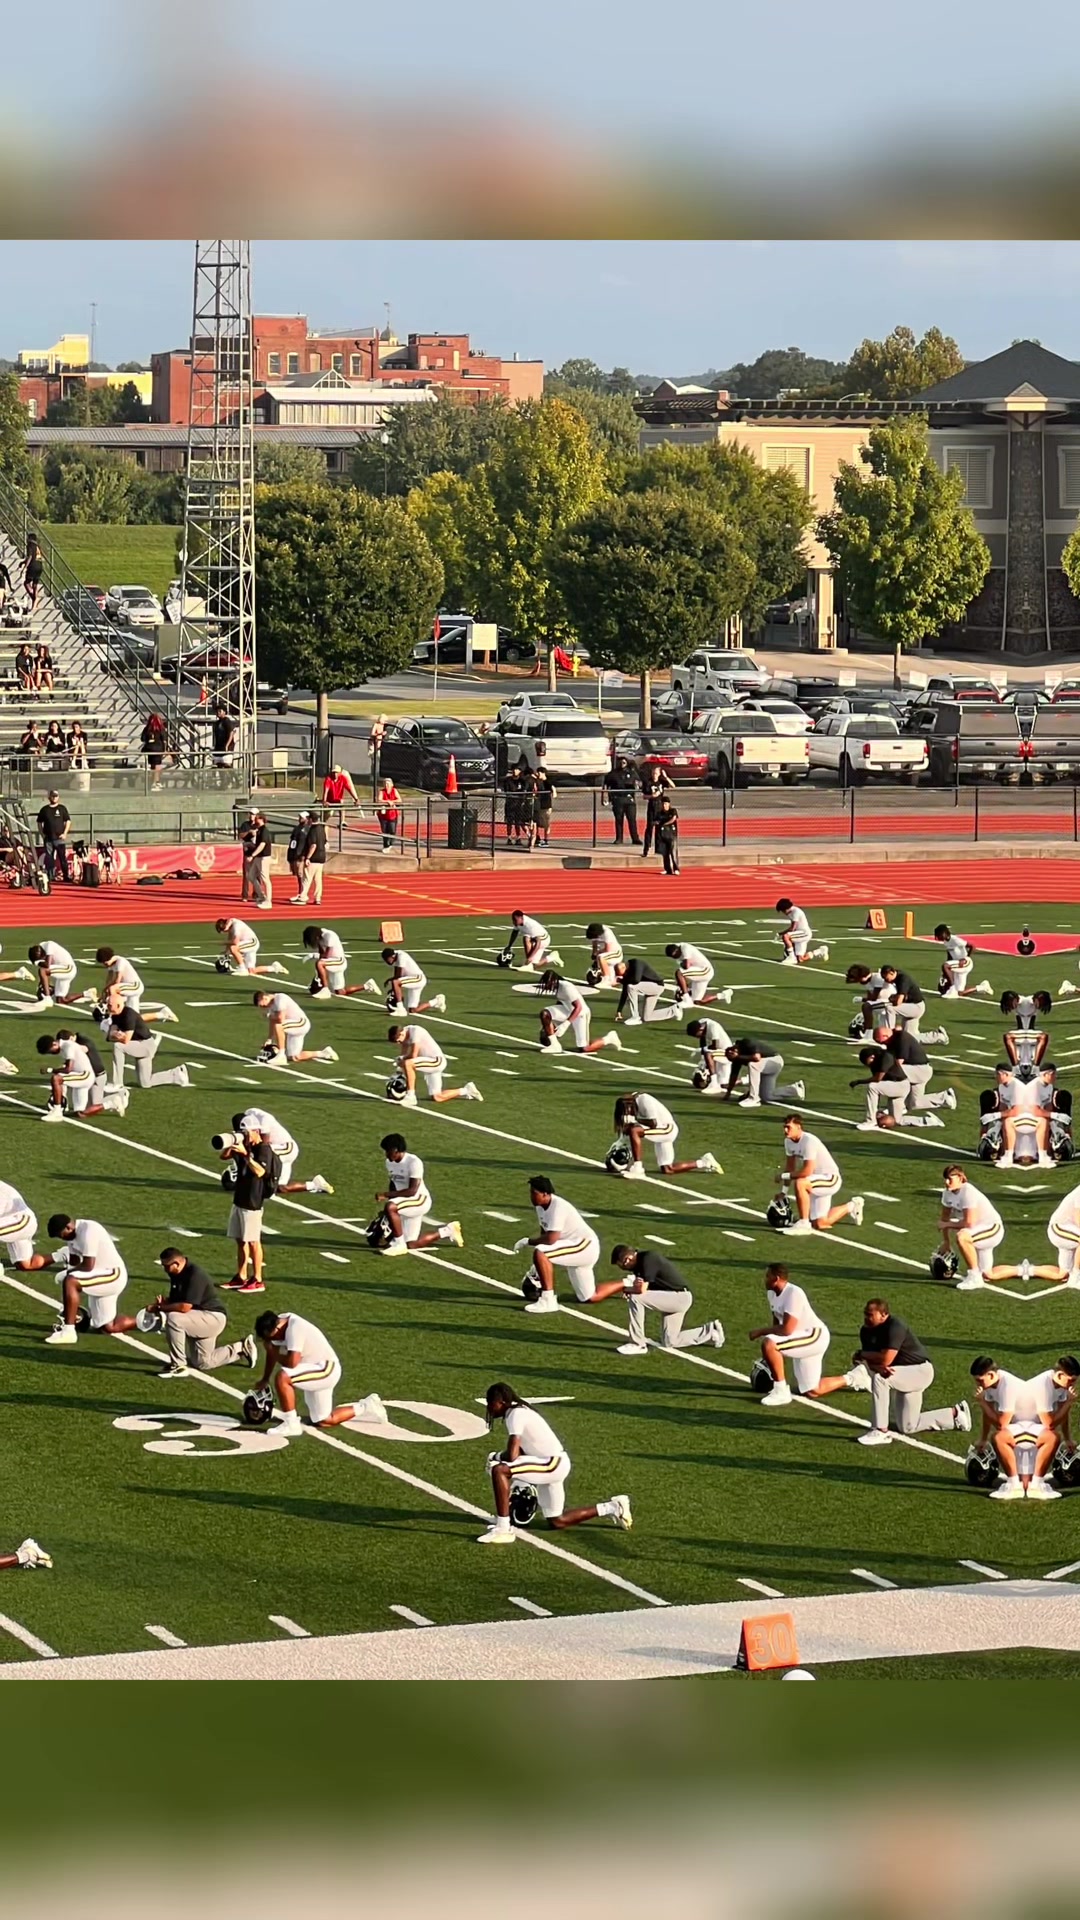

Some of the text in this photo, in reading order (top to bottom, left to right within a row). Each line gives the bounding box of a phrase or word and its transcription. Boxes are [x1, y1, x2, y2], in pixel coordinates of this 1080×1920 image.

[875, 911, 885, 927] G
[112, 1400, 491, 1457] 30
[750, 1621, 793, 1664] 30
